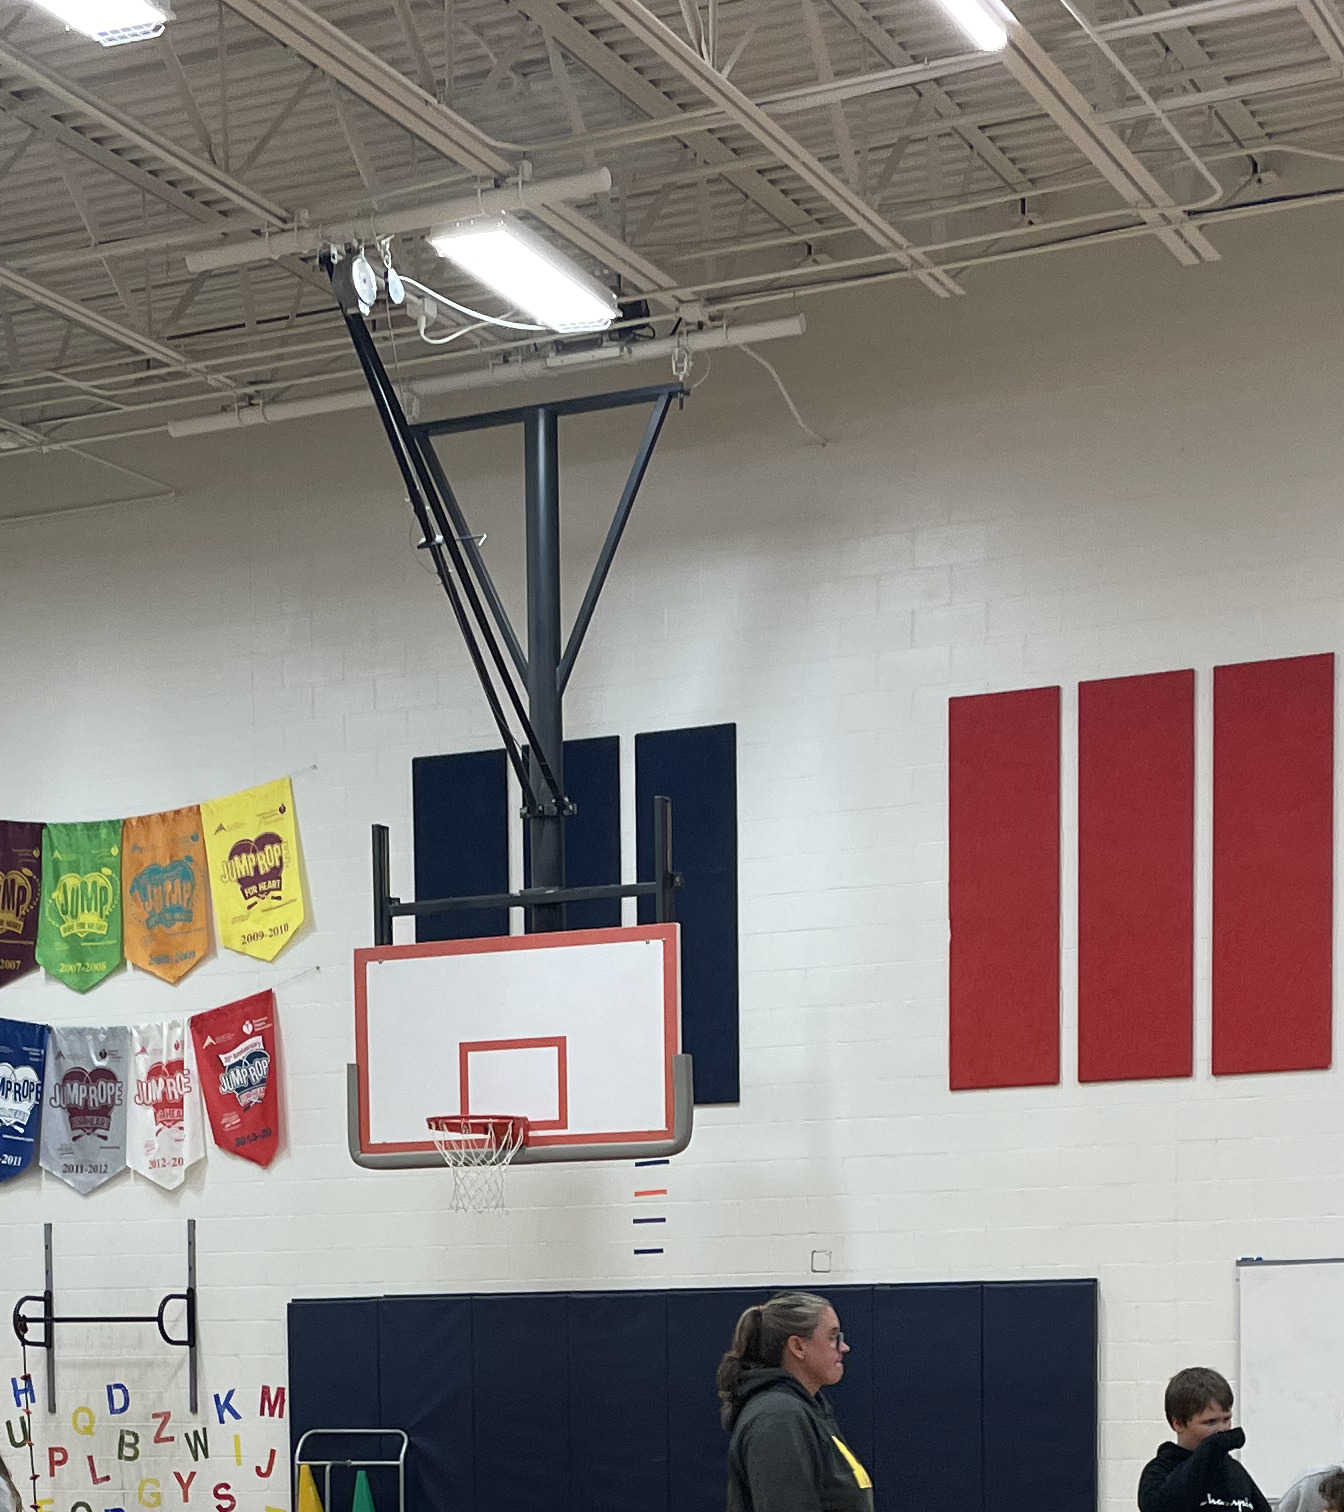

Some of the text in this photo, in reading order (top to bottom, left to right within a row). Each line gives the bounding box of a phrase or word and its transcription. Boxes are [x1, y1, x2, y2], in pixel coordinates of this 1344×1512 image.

[61, 878, 109, 920] JUMP
[241, 922, 290, 945] 2009-2010
[220, 1058, 268, 1094] JUMP ROP
[50, 1080, 124, 1110] JUMP ROPE
[62, 1163, 109, 1174] 2011-2012
[11, 1377, 36, 1408] H
[106, 1382, 131, 1415] D
[213, 1388, 242, 1424] K
[259, 1385, 286, 1419] M
[6, 1416, 29, 1449] U
[72, 1406, 97, 1437] Q
[151, 1411, 175, 1444] Z
[118, 1429, 140, 1462] B
[184, 1427, 210, 1462] W
[233, 1434, 243, 1467] I
[48, 1446, 69, 1478] P
[87, 1455, 111, 1485] L
[255, 1449, 277, 1479] J
[137, 1477, 162, 1509] G
[173, 1471, 197, 1503] Y
